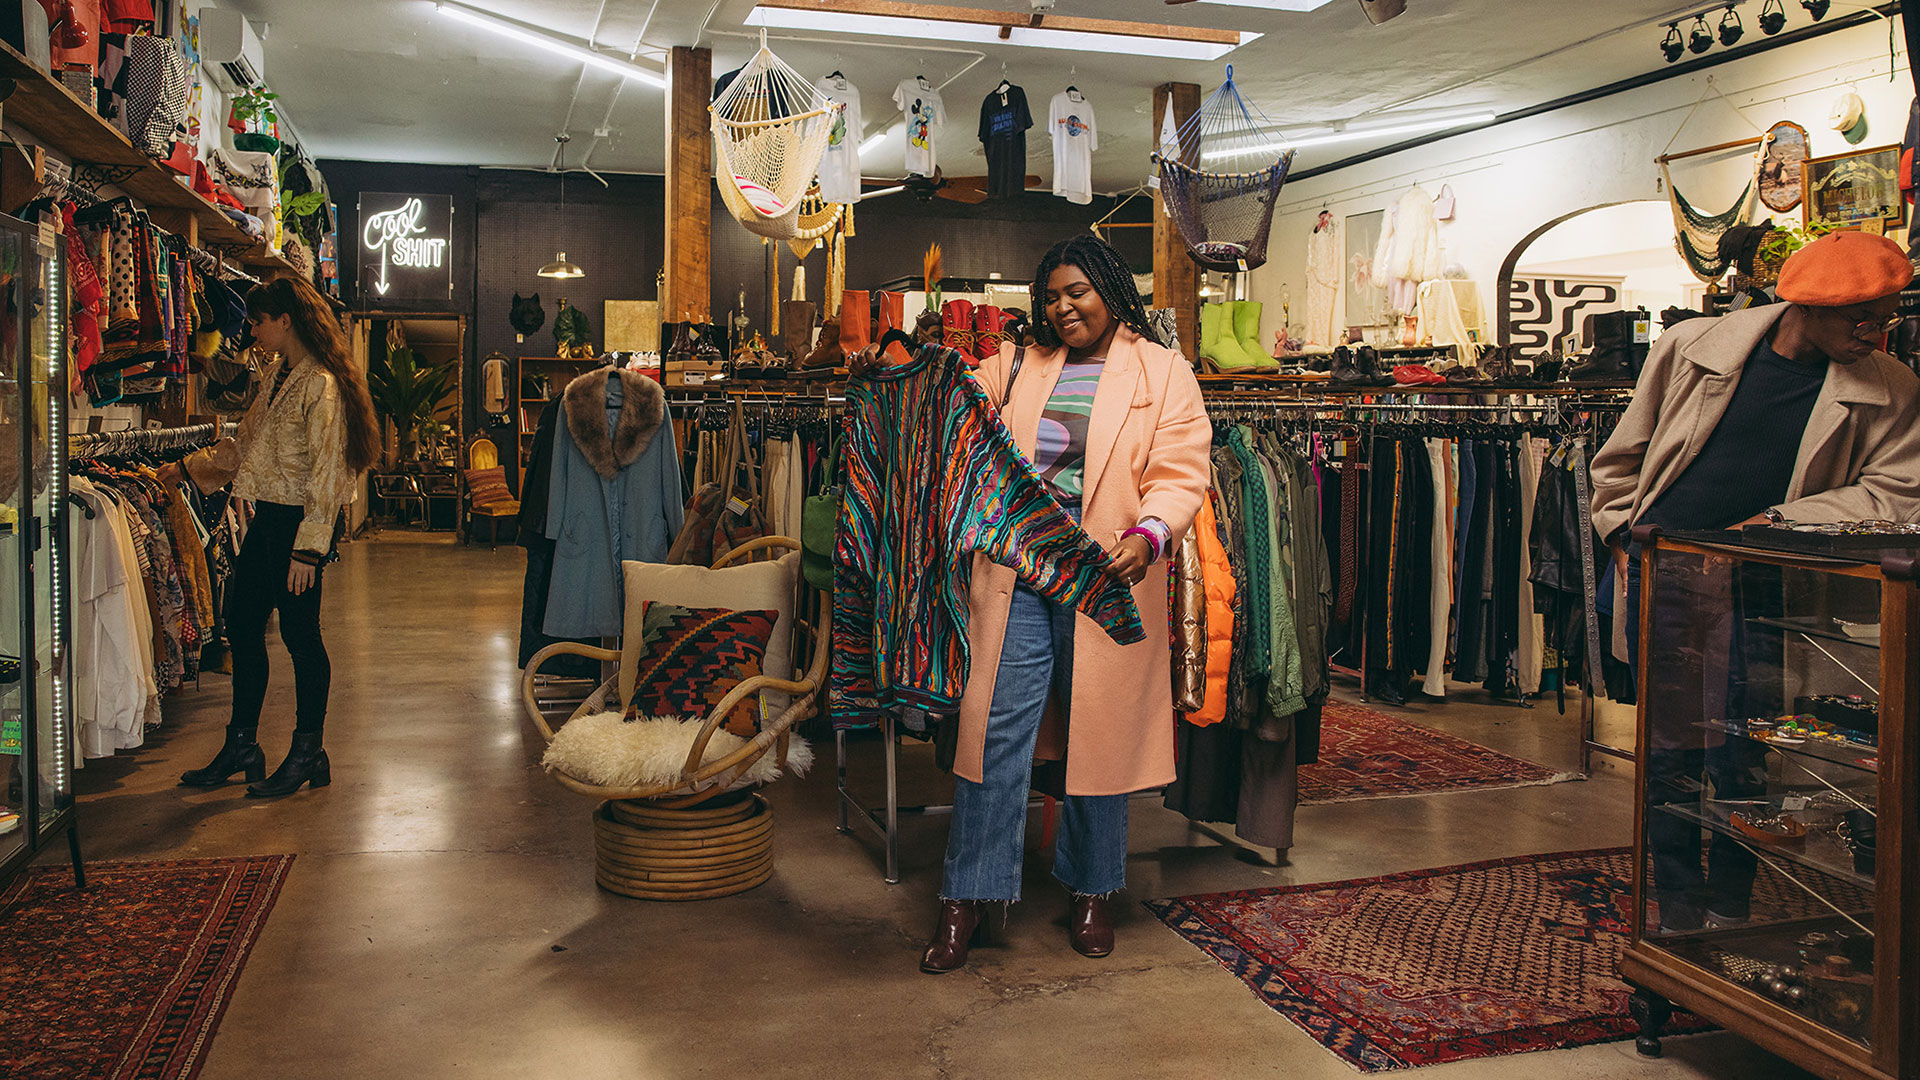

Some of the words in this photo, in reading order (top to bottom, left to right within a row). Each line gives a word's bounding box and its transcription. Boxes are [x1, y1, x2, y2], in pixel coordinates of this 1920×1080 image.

[364, 197, 427, 250] Cool
[392, 238, 446, 268] SHIT
[1568, 338, 1575, 353] 7
